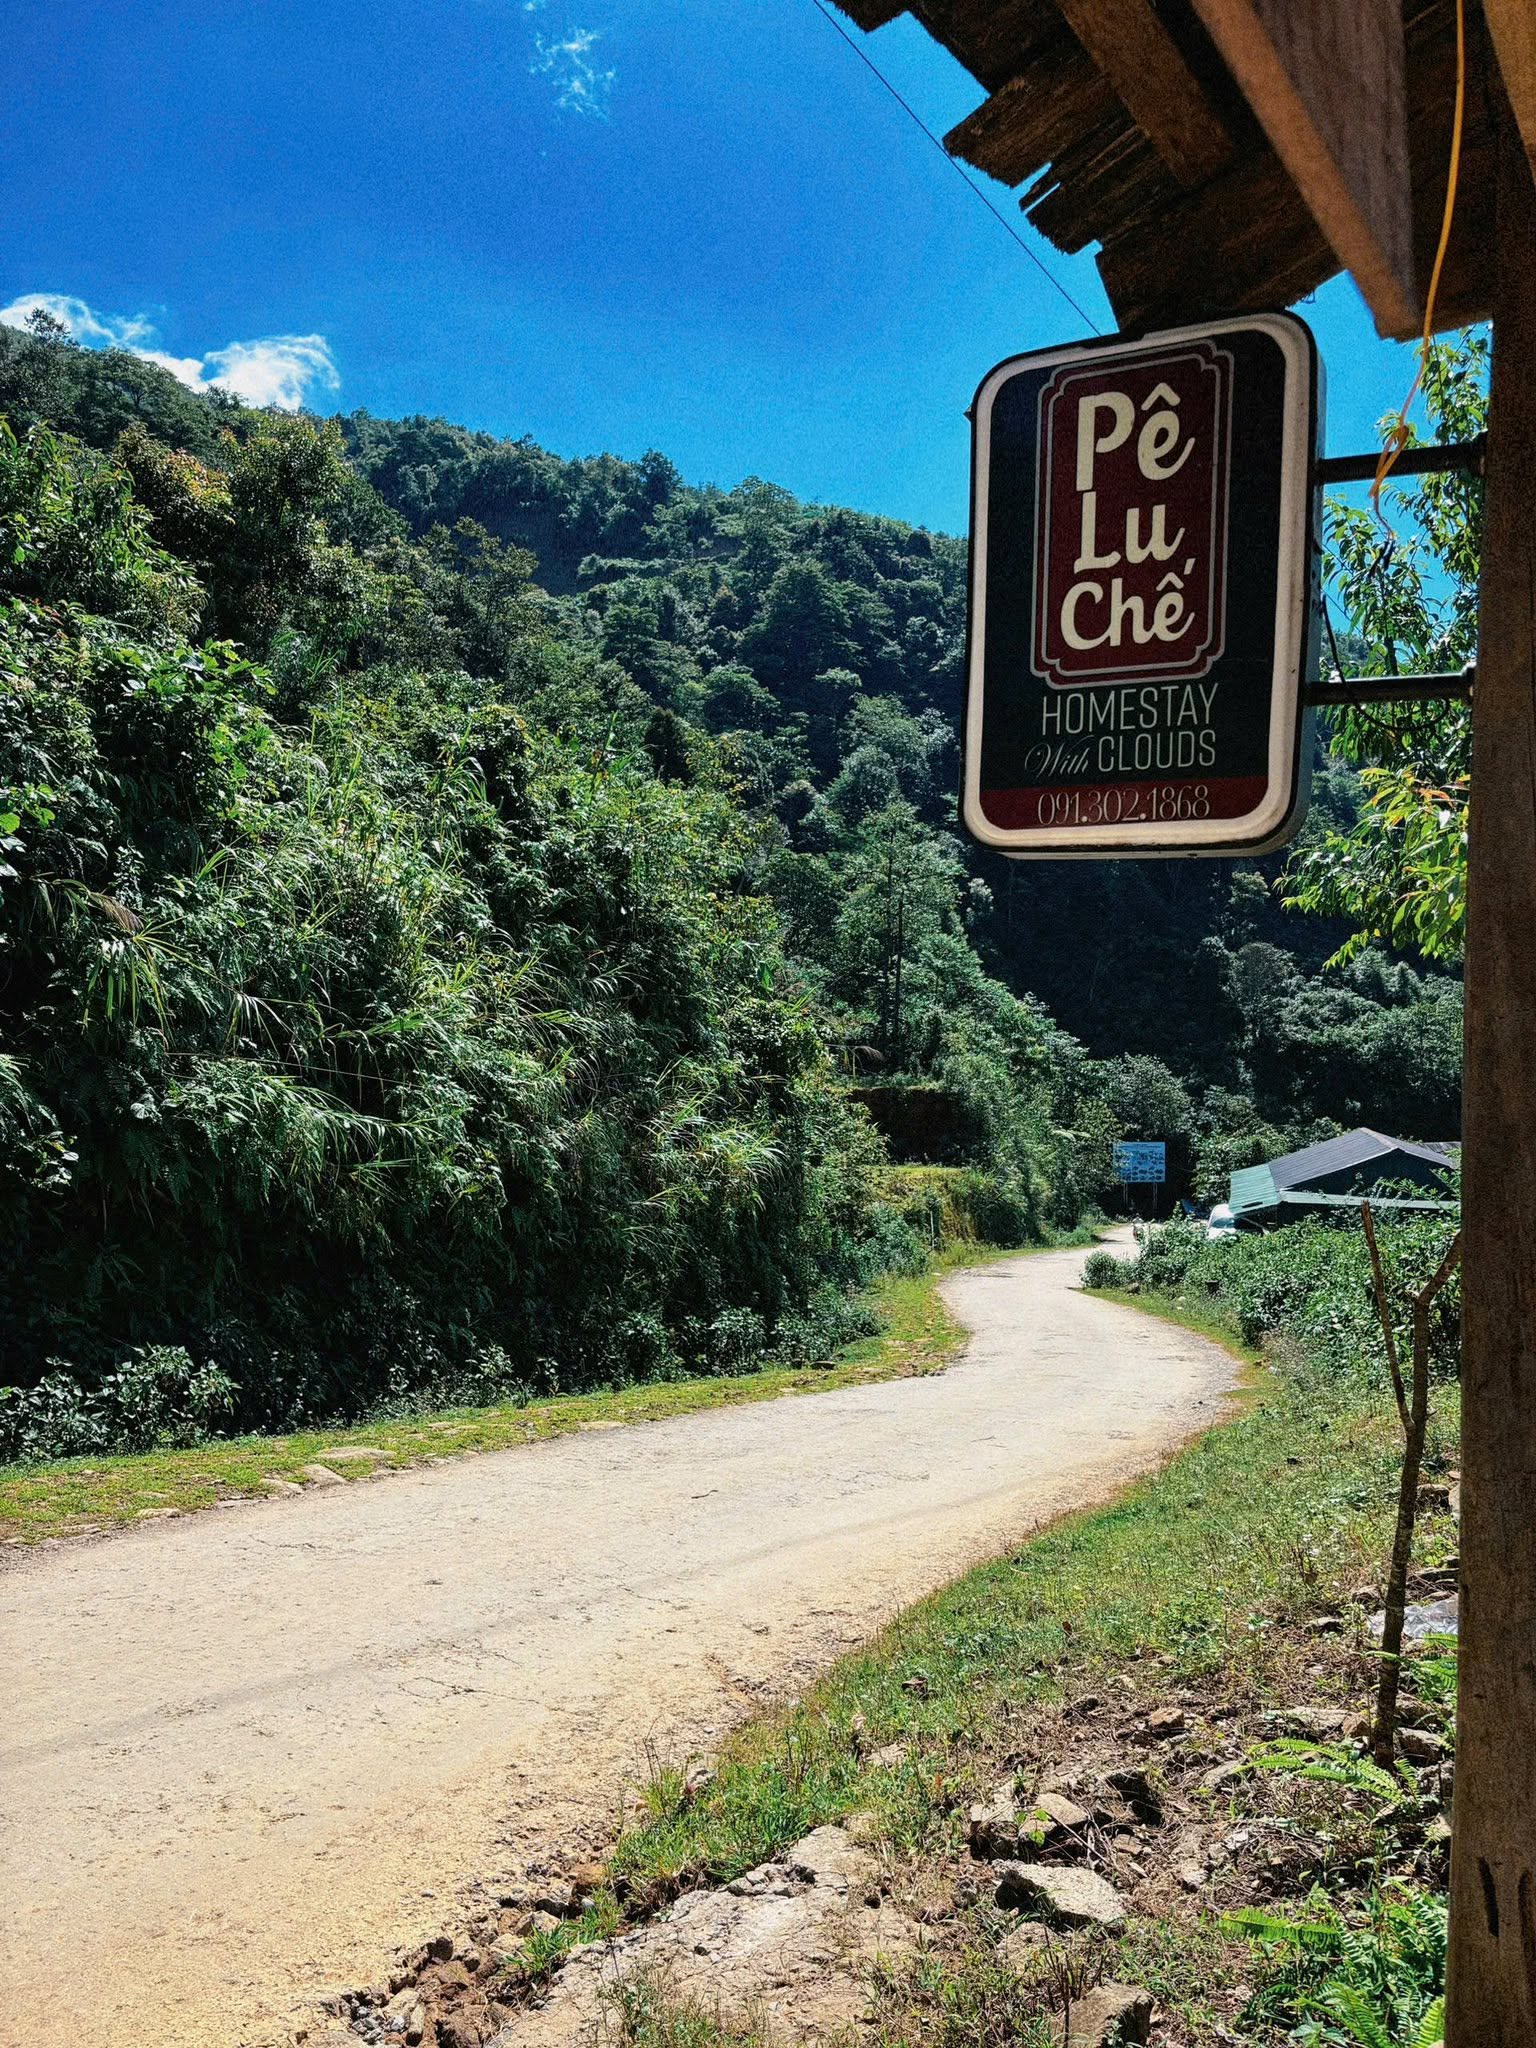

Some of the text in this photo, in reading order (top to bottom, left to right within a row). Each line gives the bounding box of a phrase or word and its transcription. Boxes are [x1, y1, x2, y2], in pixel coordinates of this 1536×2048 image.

[1076, 382, 1195, 491] Pê
[1073, 491, 1185, 574] Lu
[1060, 556, 1195, 650] Chế
[1042, 683, 1219, 736] HOMESTAY
[1024, 729, 1216, 778] With CLOUDS
[1038, 785, 1210, 825] 091.302.1868
